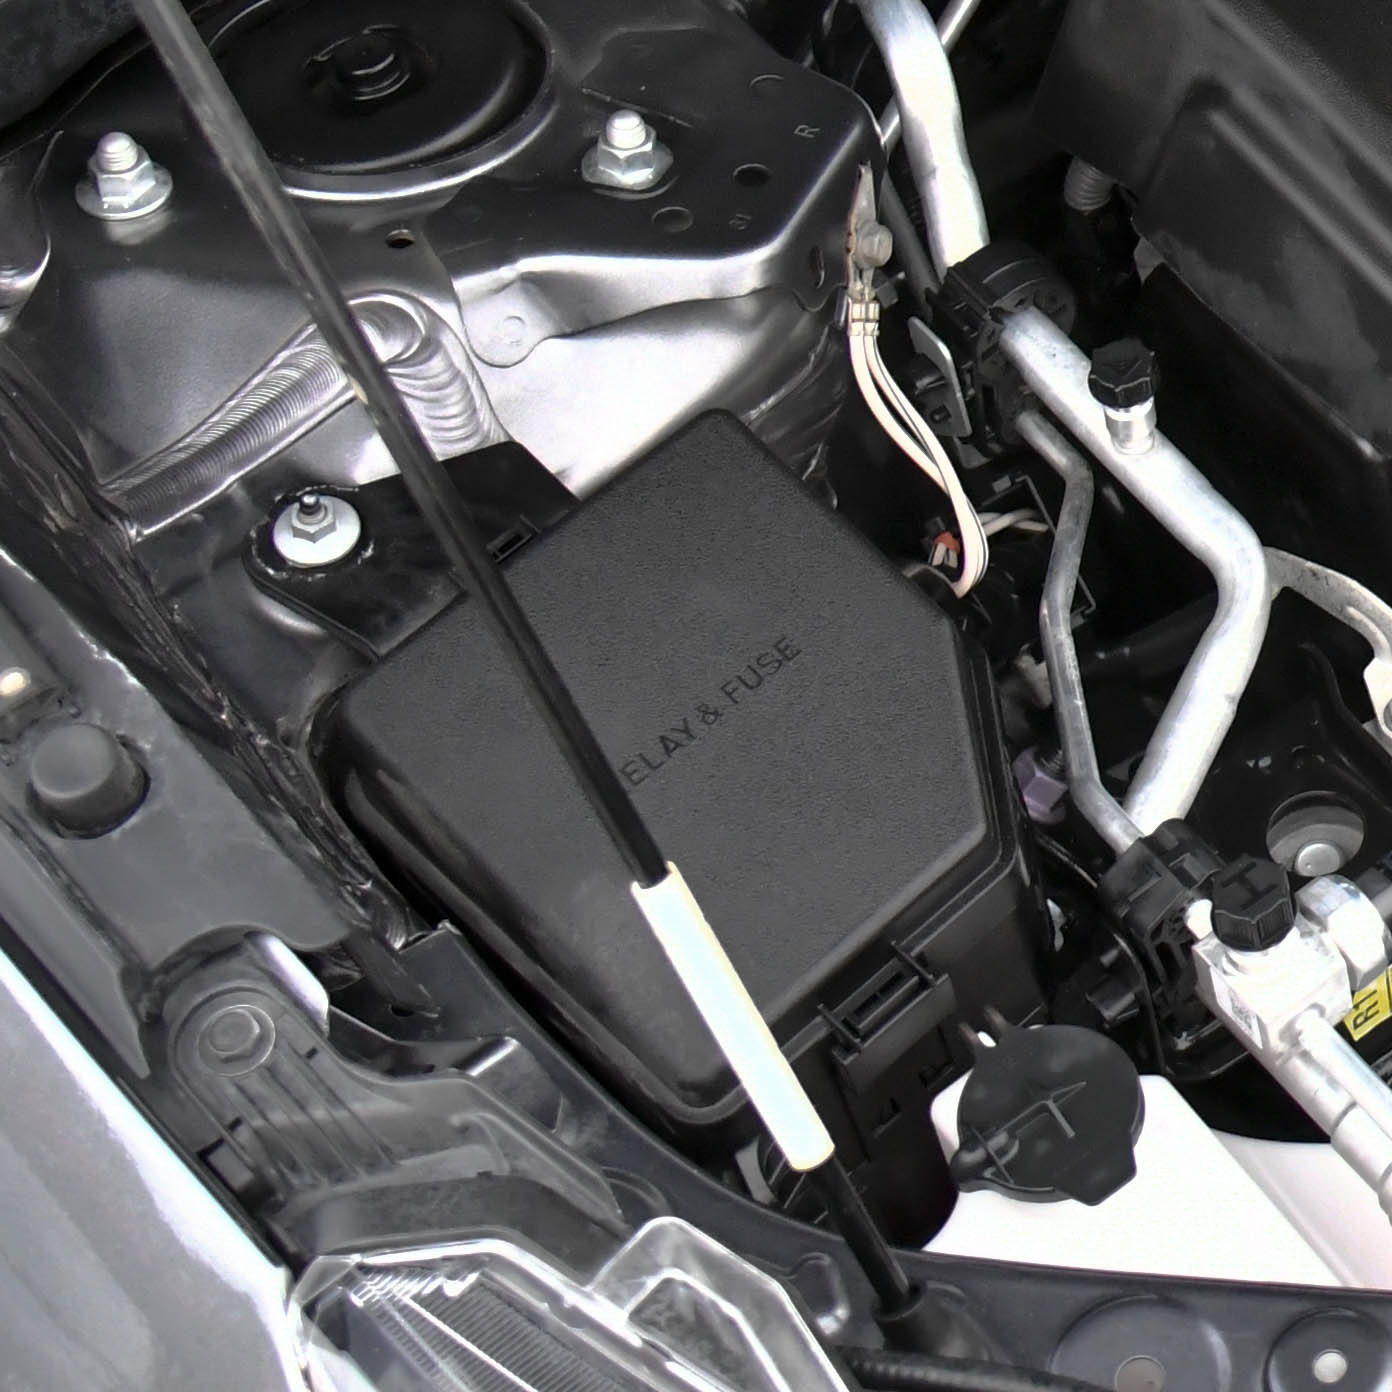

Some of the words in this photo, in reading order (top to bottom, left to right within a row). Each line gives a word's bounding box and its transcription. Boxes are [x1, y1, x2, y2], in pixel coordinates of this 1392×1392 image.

[619, 718, 697, 787] ELAY
[695, 703, 723, 726] &
[721, 635, 802, 705] FUSE
